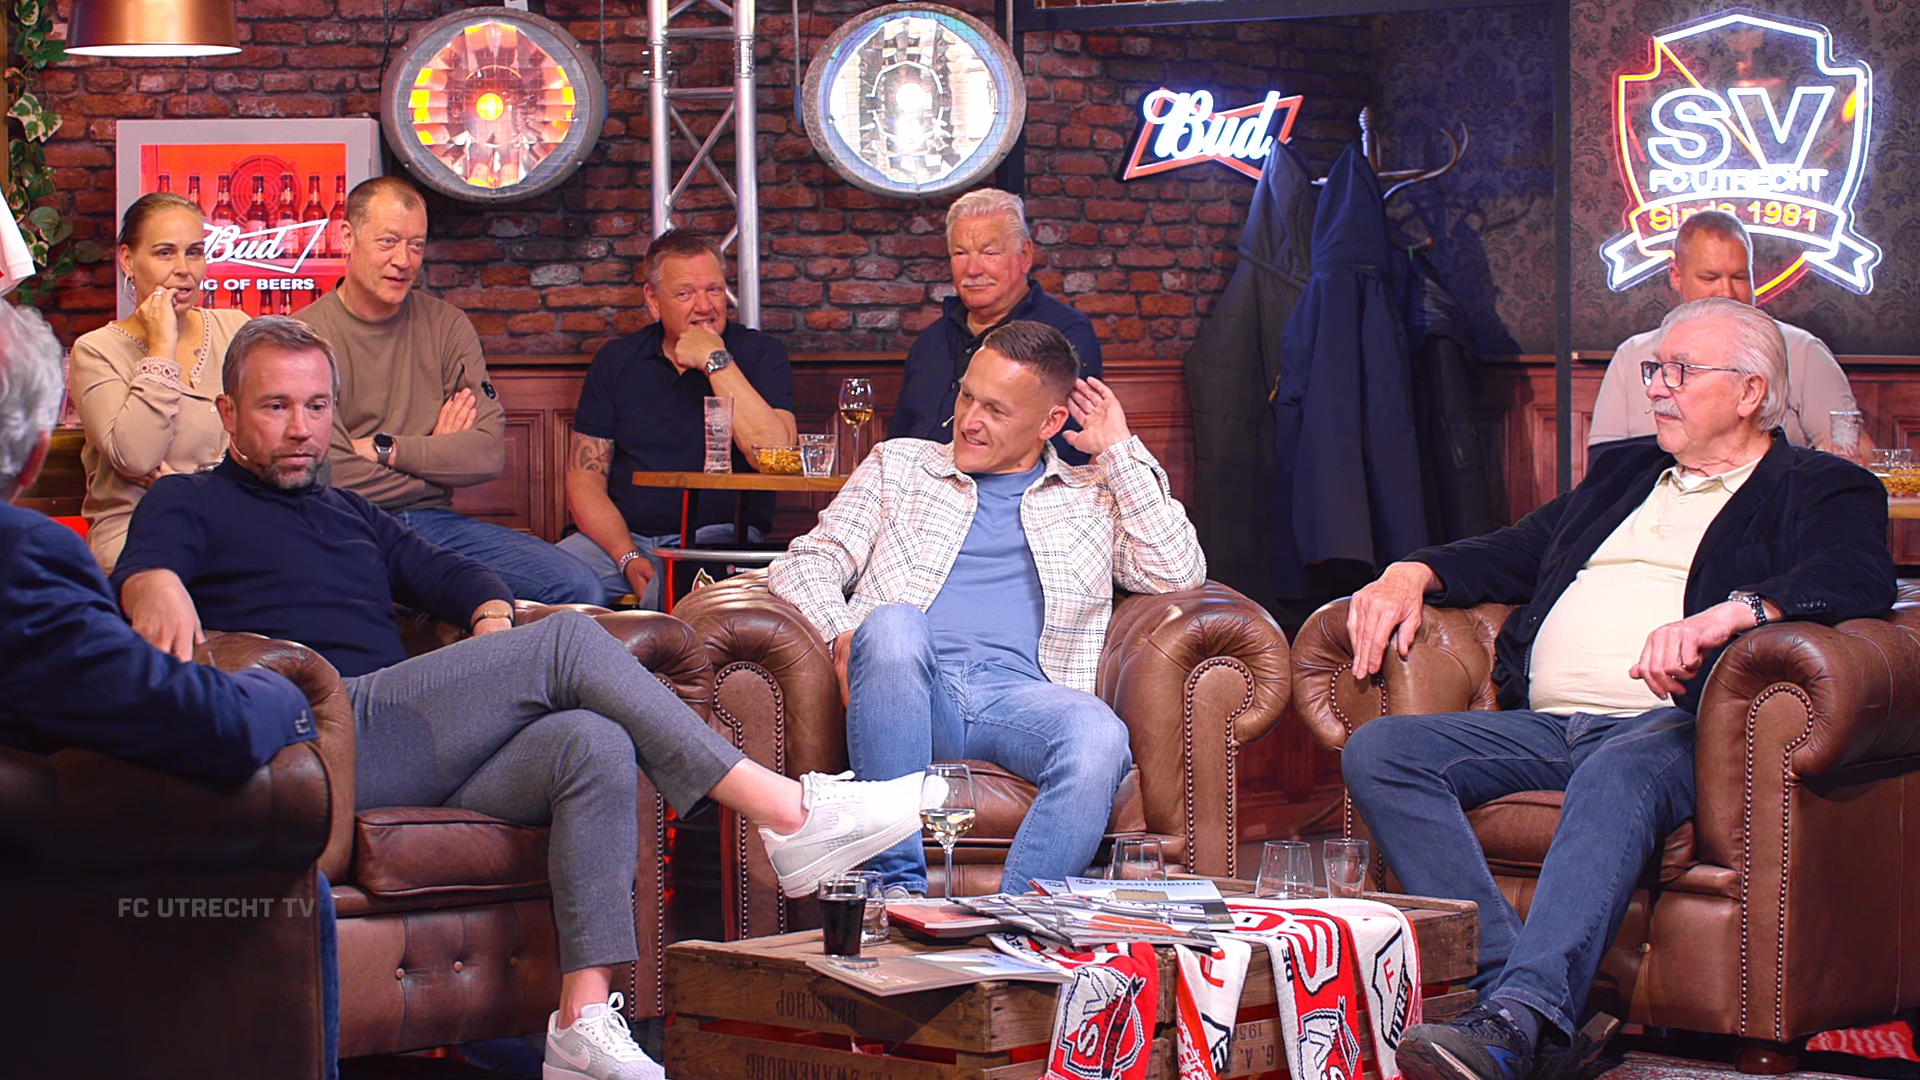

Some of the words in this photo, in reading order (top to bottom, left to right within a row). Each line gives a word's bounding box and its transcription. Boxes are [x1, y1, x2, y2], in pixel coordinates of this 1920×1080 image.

[1647, 85, 1836, 171] SV
[1649, 169, 1690, 193] FC
[1690, 168, 1829, 193] UTRECHT
[1649, 200, 1736, 231] Sin
[1747, 200, 1817, 232] 1981
[203, 221, 285, 264] Bud
[223, 278, 251, 291] OF
[256, 278, 315, 291] BEERS
[775, 989, 858, 1027] BENSCHOP
[1239, 1046, 1254, 1070] A.
[1261, 1044, 1275, 1067] G.
